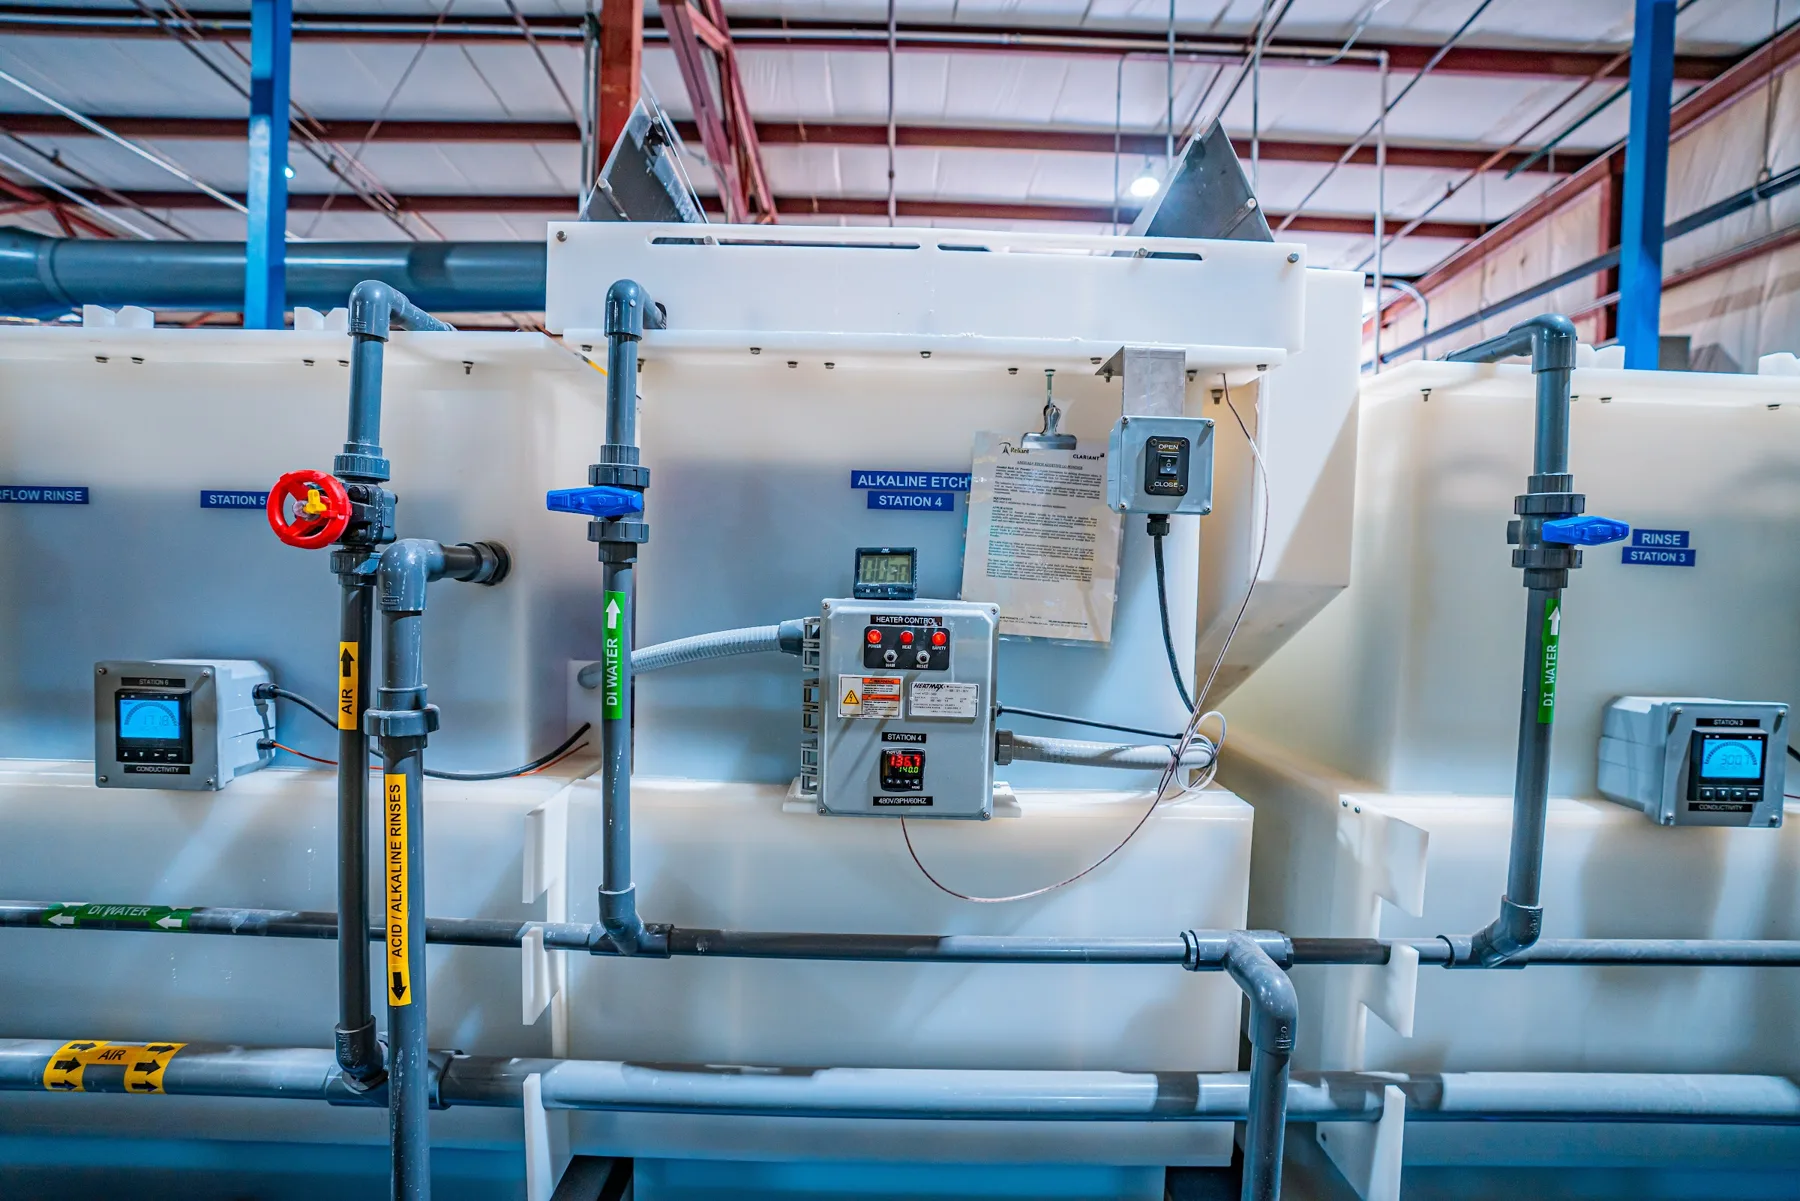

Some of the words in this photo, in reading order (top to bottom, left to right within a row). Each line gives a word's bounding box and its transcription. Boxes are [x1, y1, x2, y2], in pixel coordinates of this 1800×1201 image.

[858, 474, 927, 486] ALKALINE
[932, 476, 968, 488] ETCH
[44, 490, 83, 502] RINSE
[210, 494, 256, 505] STATION
[260, 496, 266, 506] 5
[879, 495, 932, 507] STATION
[934, 497, 942, 507] 4
[1642, 533, 1681, 546] RINSE
[1630, 550, 1676, 562] STATION
[1679, 553, 1686, 562] 3
[876, 616, 903, 624] HEATER
[904, 616, 936, 625] CONTROL
[606, 637, 618, 690] WATER
[1544, 644, 1558, 684] WATER
[340, 688, 352, 716] AIR
[606, 692, 618, 706] DI
[1543, 687, 1554, 707] DI
[887, 733, 916, 741] STATION
[390, 784, 402, 838] RINSES
[391, 842, 402, 912] ALKALINE
[88, 906, 102, 914] DI
[102, 906, 151, 916] WATER
[392, 924, 402, 958] ACID
[98, 1050, 126, 1060] AIR
